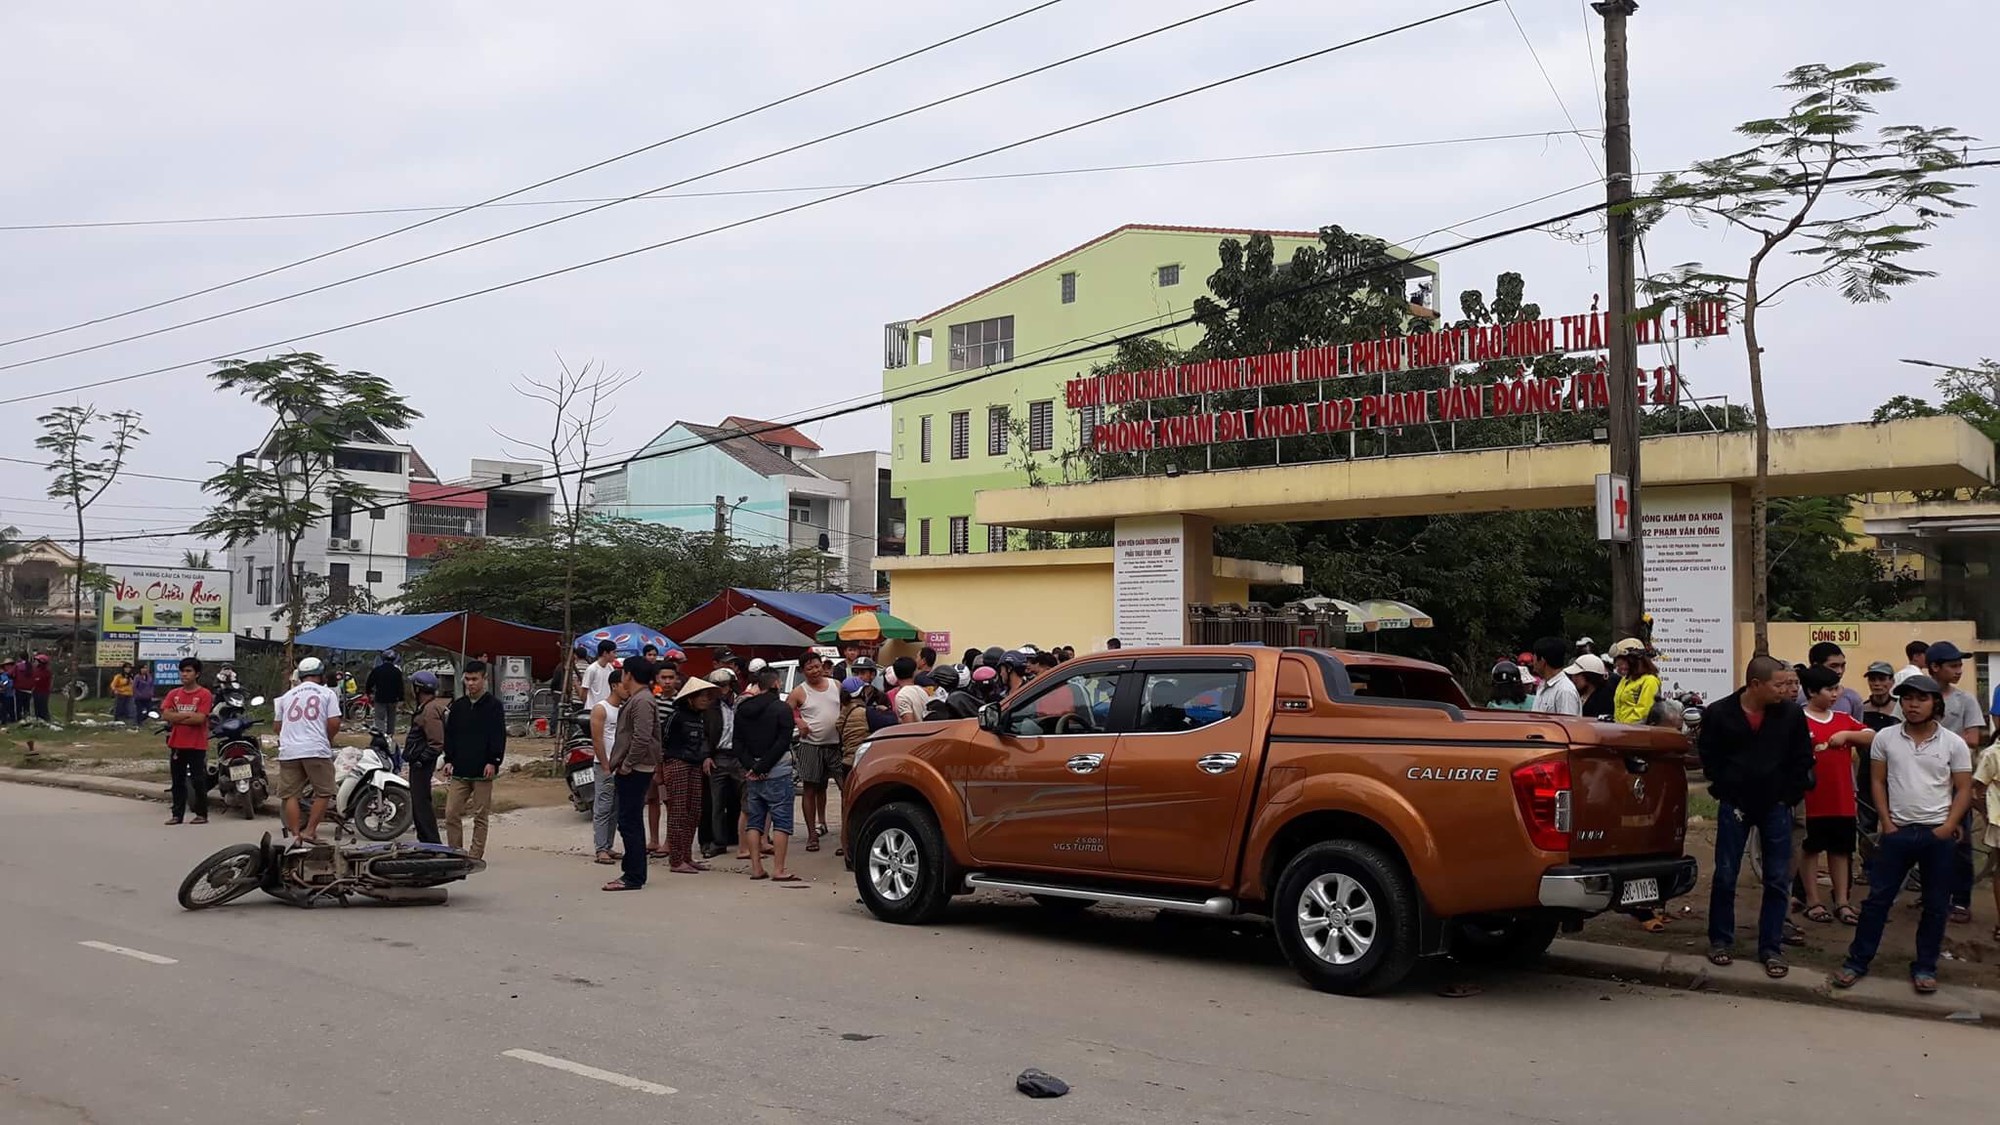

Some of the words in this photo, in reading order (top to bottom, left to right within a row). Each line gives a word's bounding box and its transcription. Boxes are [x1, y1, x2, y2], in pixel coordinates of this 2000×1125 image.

[1066, 372, 1100, 413] BỆNH
[1103, 367, 1135, 406] VIỆN
[1180, 354, 1241, 394] THƯƠNG
[1561, 293, 1610, 352] THẨ
[1160, 405, 1216, 448] KHÁM
[1219, 409, 1248, 442] ĐA
[1253, 401, 1311, 438] KHOA
[1316, 397, 1355, 433] 102
[1361, 389, 1427, 436] PHẠM
[1437, 380, 1484, 421] VĂN
[1492, 364, 1563, 417] ĐỒNG
[1641, 513, 1661, 523] HÒNG
[1701, 512, 1724, 521] KHOA
[1642, 529, 1652, 537] 02
[1852, 630, 1858, 641] 1
[156, 663, 181, 672] QUA
[287, 695, 320, 722] 68
[1406, 767, 1499, 781] CALIBRE
[1072, 844, 1104, 852] TURBO
